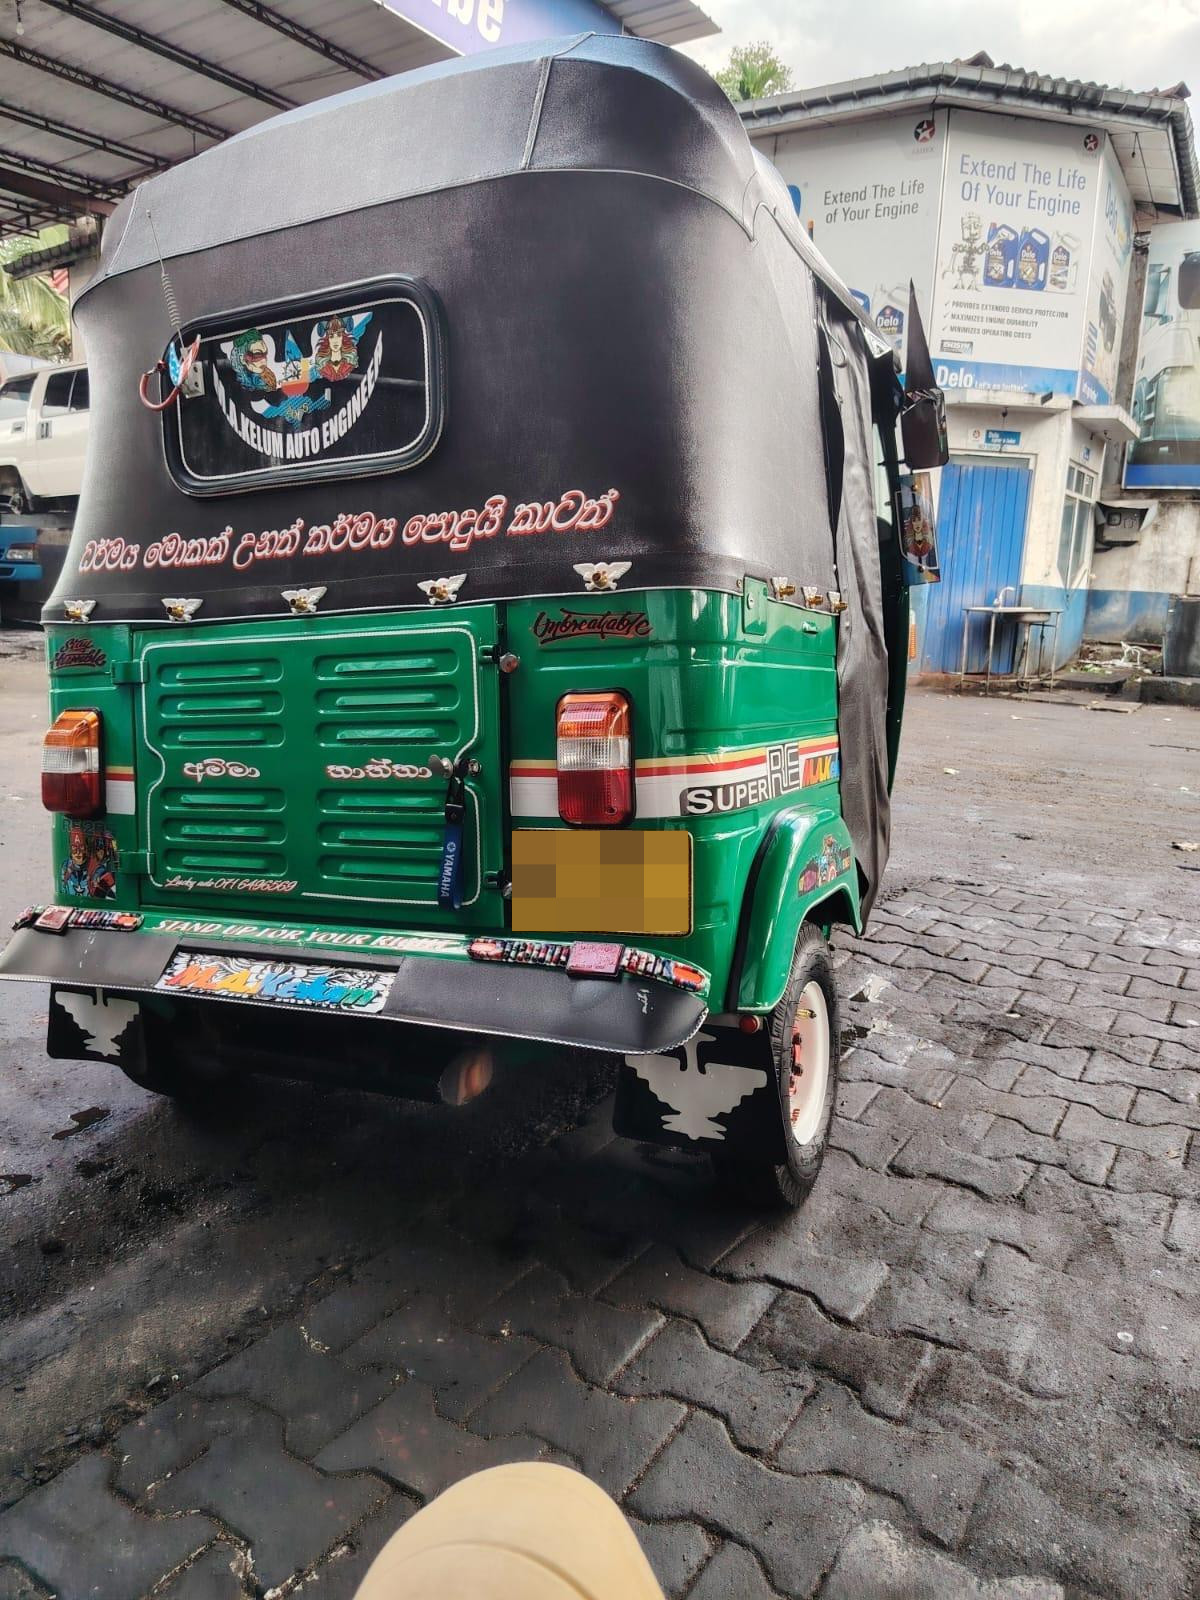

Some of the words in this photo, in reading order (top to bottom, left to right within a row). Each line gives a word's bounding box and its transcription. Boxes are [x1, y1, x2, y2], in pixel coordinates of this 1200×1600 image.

[960, 154, 1016, 181] Extend
[1022, 162, 1051, 186] The
[1057, 167, 1086, 190] Life
[823, 186, 867, 206] Extend
[872, 184, 895, 199] The
[900, 179, 925, 196] Life
[961, 181, 981, 202] Of
[986, 184, 1022, 207] Your
[1027, 189, 1080, 217] Engine
[825, 208, 838, 224] of
[842, 206, 870, 222] Your
[874, 201, 919, 220] Engine
[951, 300, 980, 310] PROVIDES
[981, 303, 1010, 313] EXTENDED
[874, 316, 899, 328] Delo
[949, 326, 981, 335] MINIMIZES
[981, 329, 1012, 338] OPERATING
[936, 366, 973, 388] Delo
[286, 427, 320, 459] AUTO
[322, 329, 384, 450] ENGINEER
[402, 495, 508, 550] පොදුයි
[507, 487, 619, 536] කාටත්
[183, 758, 260, 784] අම්මා
[686, 776, 769, 815] SUPER
[440, 854, 455, 898] YAMAHA
[154, 919, 223, 934] STAND
[222, 924, 256, 936] UP
[255, 925, 305, 940] FOR
[307, 928, 373, 945] YOUR
